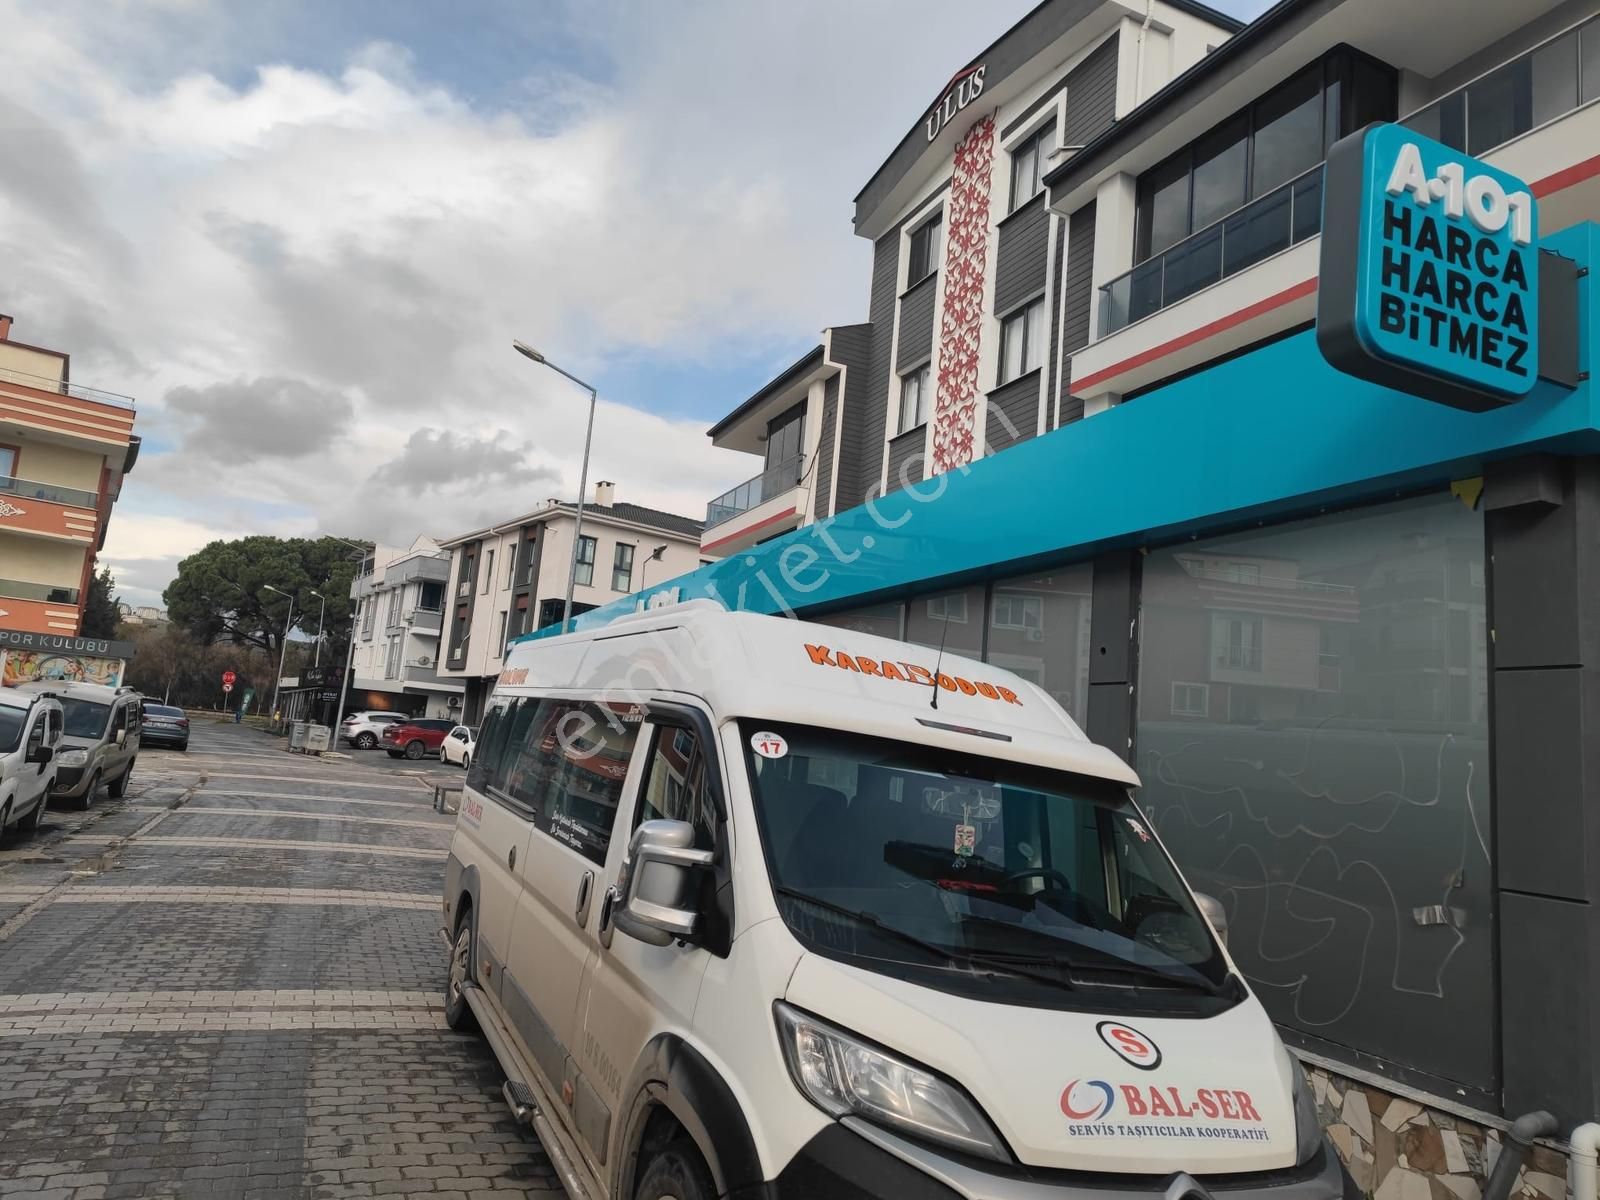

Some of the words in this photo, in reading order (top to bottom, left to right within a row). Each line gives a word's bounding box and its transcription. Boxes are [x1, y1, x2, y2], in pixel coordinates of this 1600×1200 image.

[926, 64, 986, 142] ULUS
[1383, 199, 1529, 292] HARCA
[1381, 246, 1529, 335] HARCA
[804, 644, 1024, 706] KARABODUR
[760, 741, 781, 754] 17
[1111, 1029, 1149, 1057] S
[1119, 1084, 1262, 1122] BAL-SER
[1068, 1122, 1115, 1136] SERVİS
[1117, 1125, 1195, 1138] TAŞIYICILAR
[1197, 1126, 1269, 1141] KOOPERATİFİ
